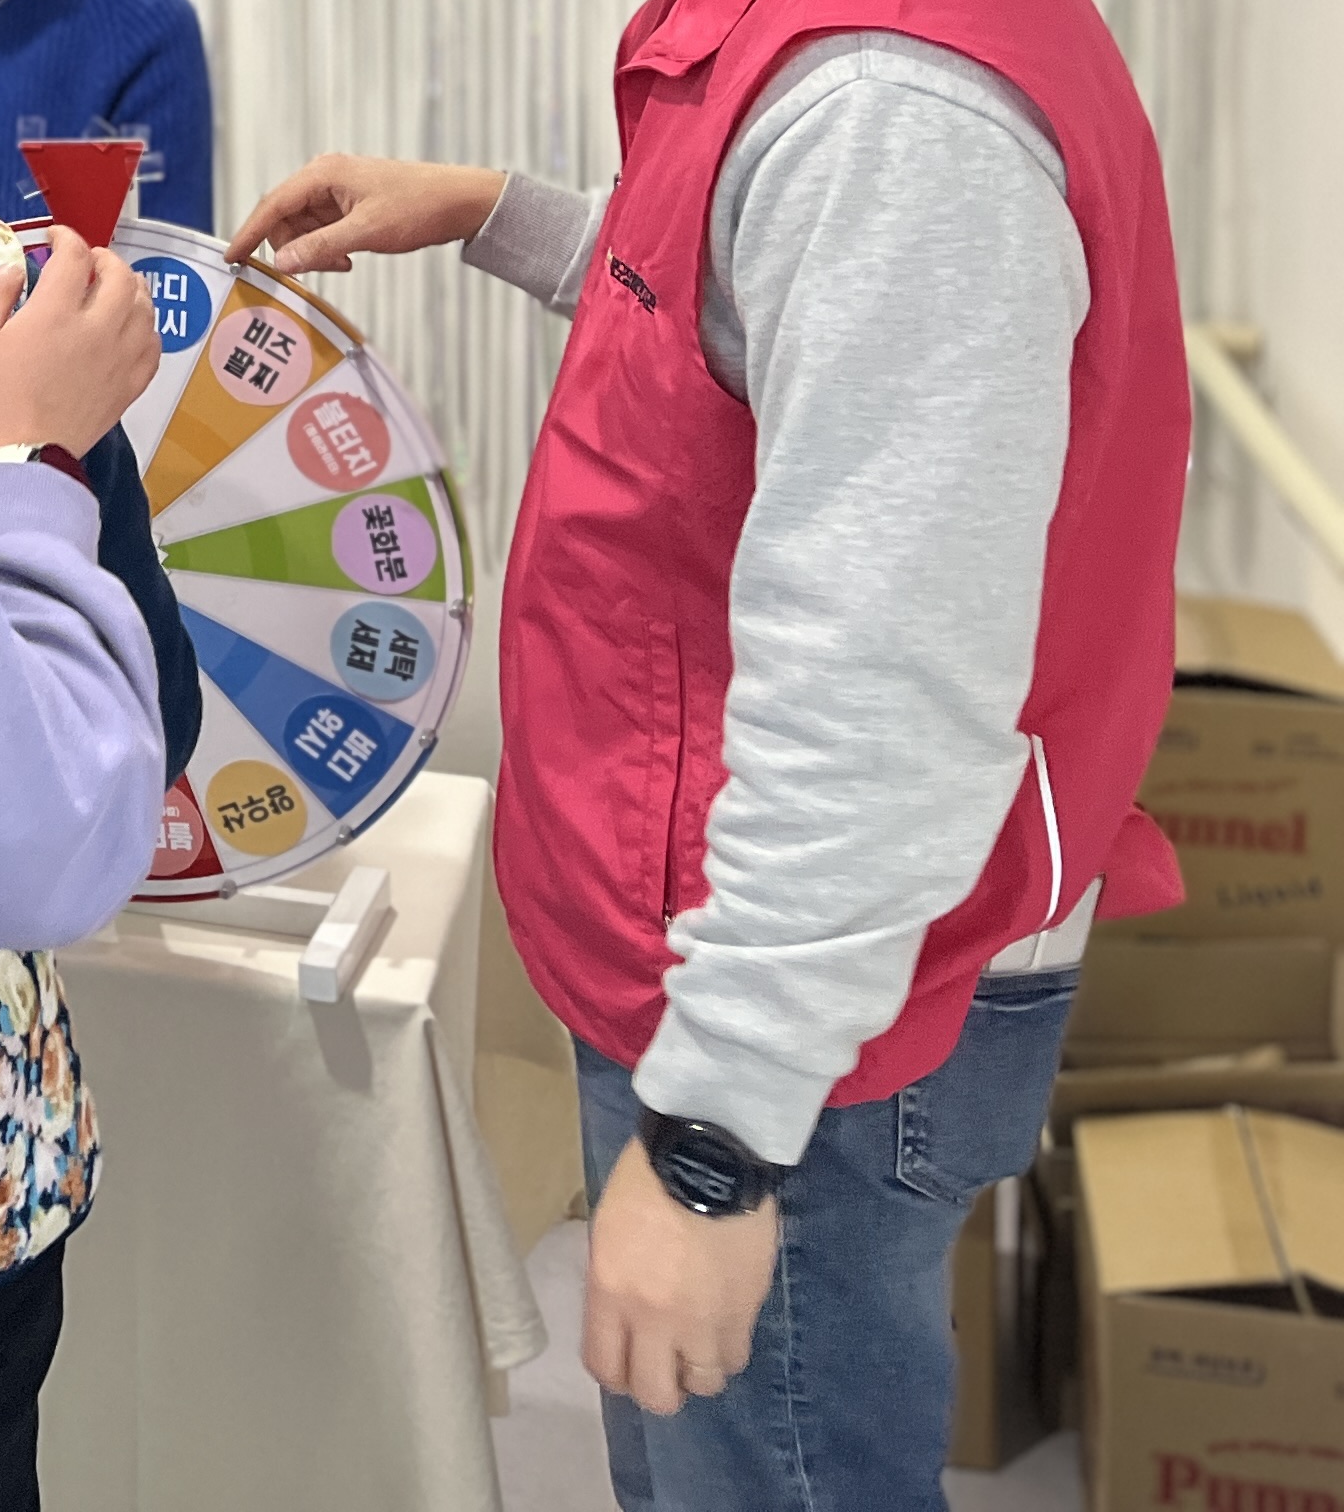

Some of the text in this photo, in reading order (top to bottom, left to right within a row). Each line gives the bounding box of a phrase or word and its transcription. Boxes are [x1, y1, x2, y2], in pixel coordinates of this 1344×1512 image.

[153, 308, 188, 338] 시
[242, 317, 297, 365] 비즈
[222, 346, 280, 395] 팔찌
[312, 399, 379, 478] 볼터치
[362, 504, 409, 582] 꽃화분
[346, 618, 382, 673] 세제
[384, 628, 420, 682] 세탁
[294, 707, 345, 760] 워시
[326, 728, 379, 782] 바디
[217, 784, 296, 834] 양우산
